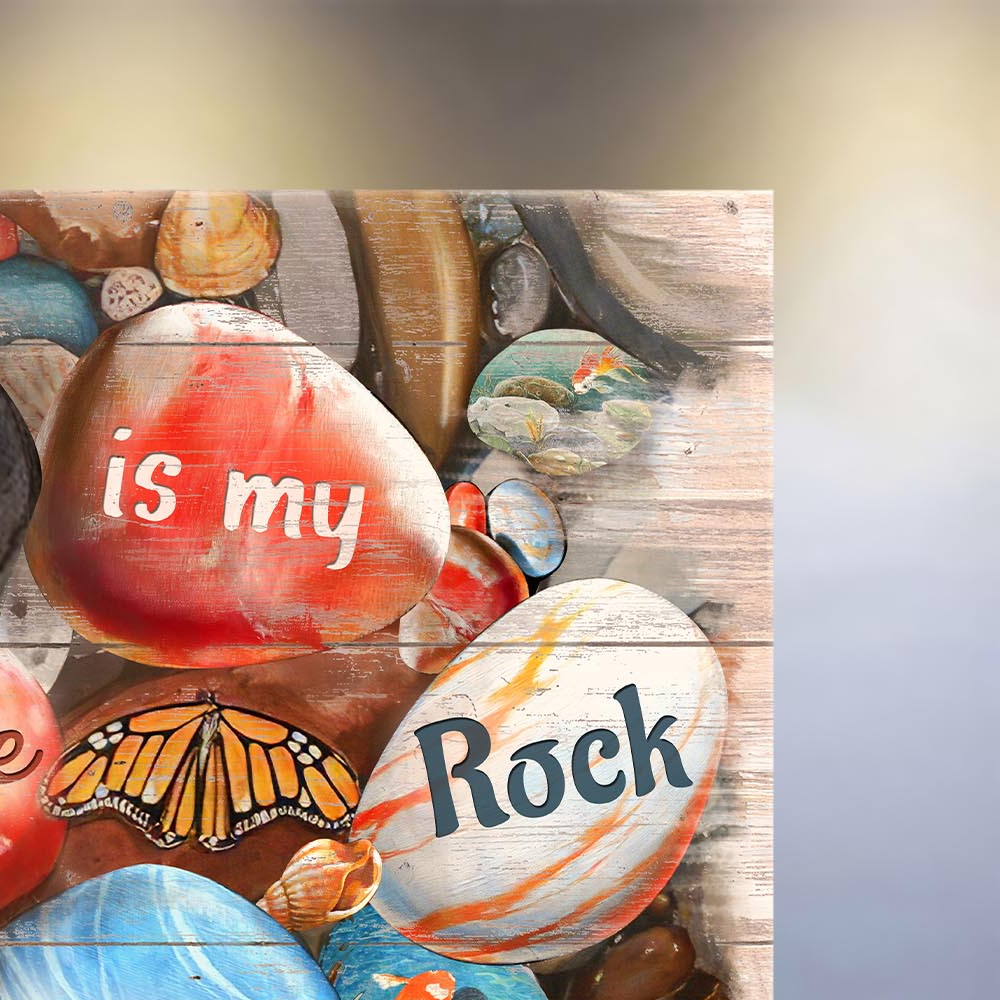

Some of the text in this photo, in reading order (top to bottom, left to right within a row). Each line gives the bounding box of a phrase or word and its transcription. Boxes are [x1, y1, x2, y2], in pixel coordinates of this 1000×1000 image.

[101, 426, 366, 570] is my
[413, 683, 693, 838] Rock
